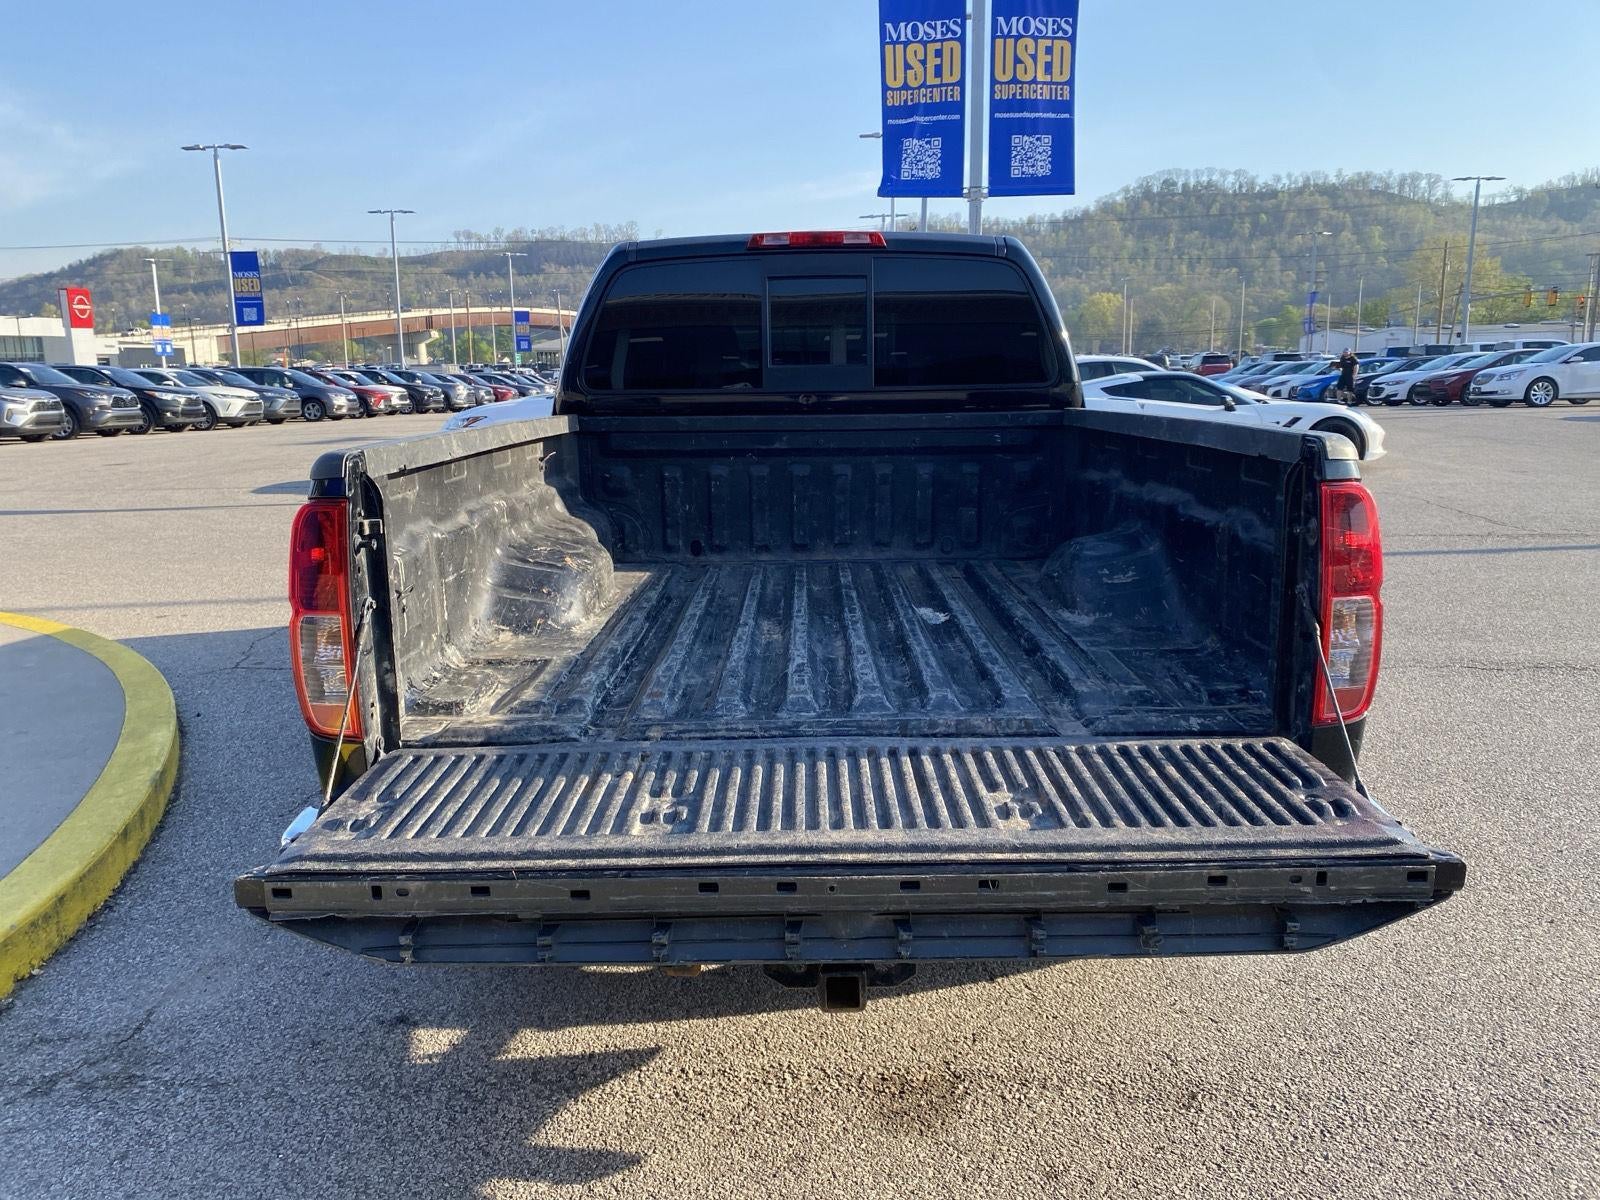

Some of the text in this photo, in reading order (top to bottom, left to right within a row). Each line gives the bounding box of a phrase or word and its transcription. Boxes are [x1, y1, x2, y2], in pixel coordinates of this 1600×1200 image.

[885, 19, 961, 42] MOSES
[996, 16, 1073, 37] MOSES
[885, 41, 961, 88] USED
[994, 38, 1071, 82] USED
[886, 86, 960, 106] SUPERCENTER
[994, 84, 1070, 100] SUPERCENTER
[234, 278, 260, 292] USED
